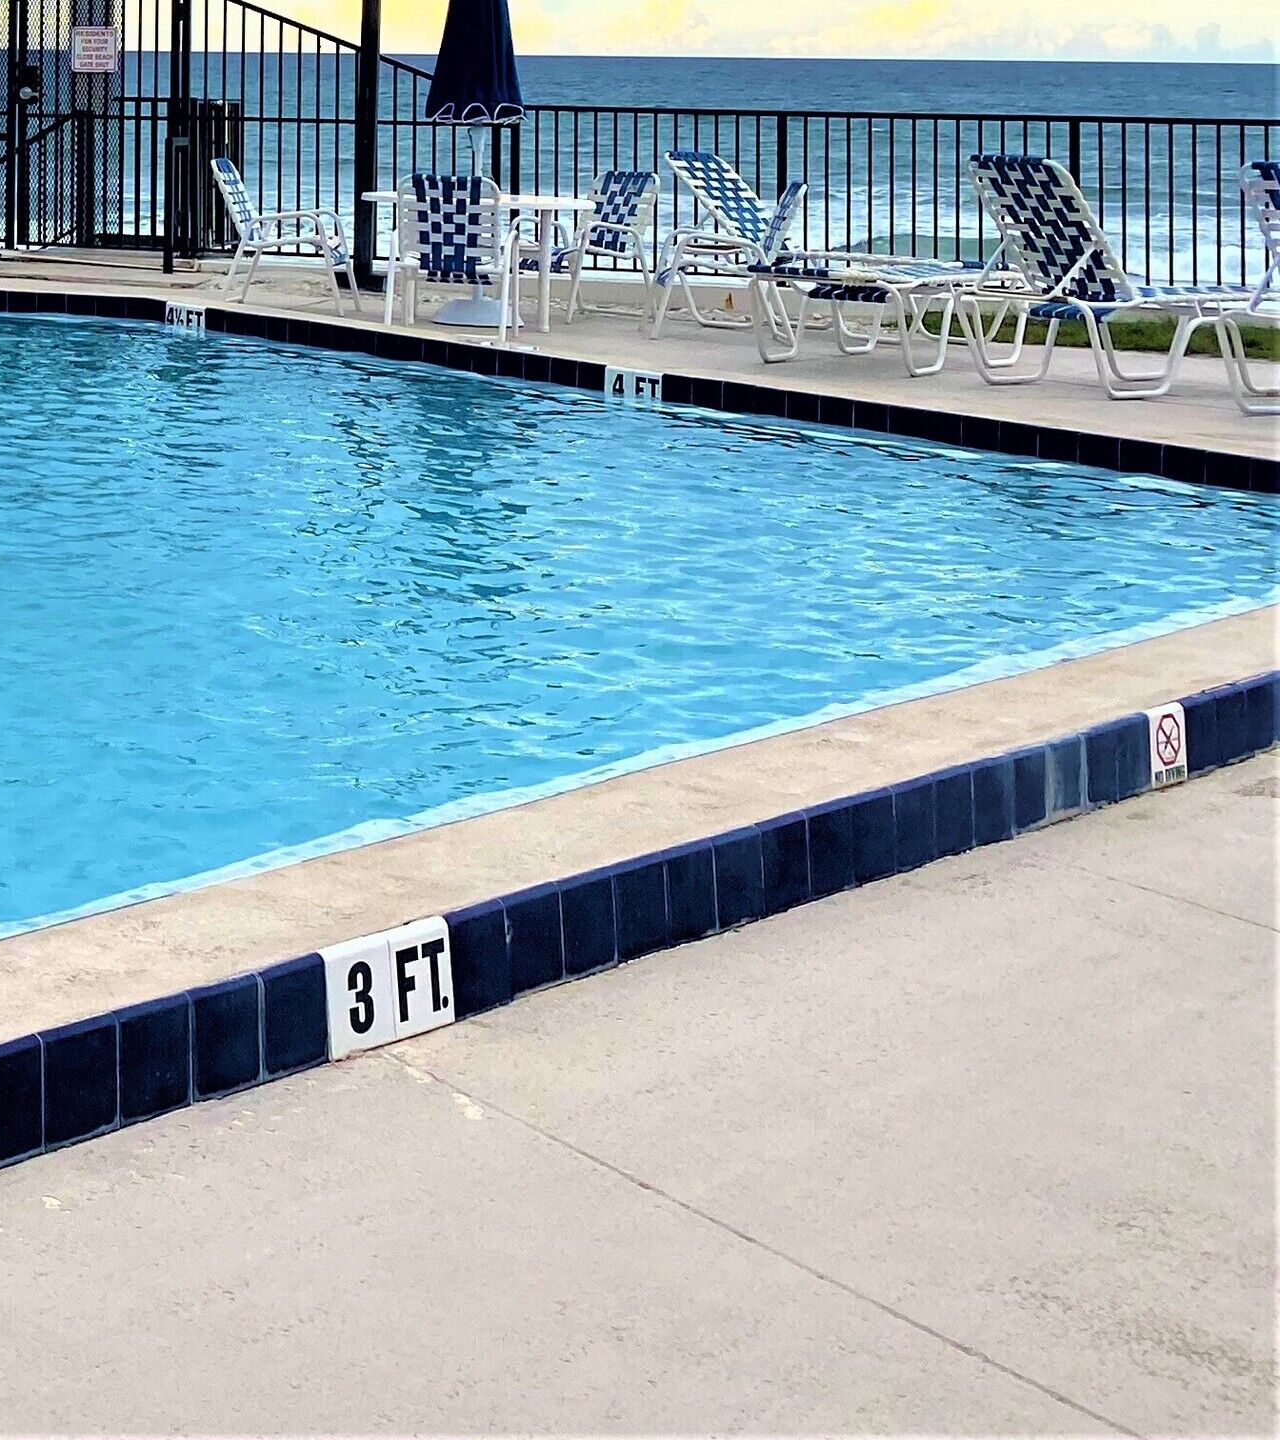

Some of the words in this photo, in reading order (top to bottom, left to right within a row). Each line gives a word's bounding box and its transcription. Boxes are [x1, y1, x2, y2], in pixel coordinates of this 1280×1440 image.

[186, 309, 203, 329] FT
[612, 373, 625, 397] 4
[635, 376, 660, 399] FT
[347, 961, 375, 1034] 3
[395, 937, 449, 1023] FT.
